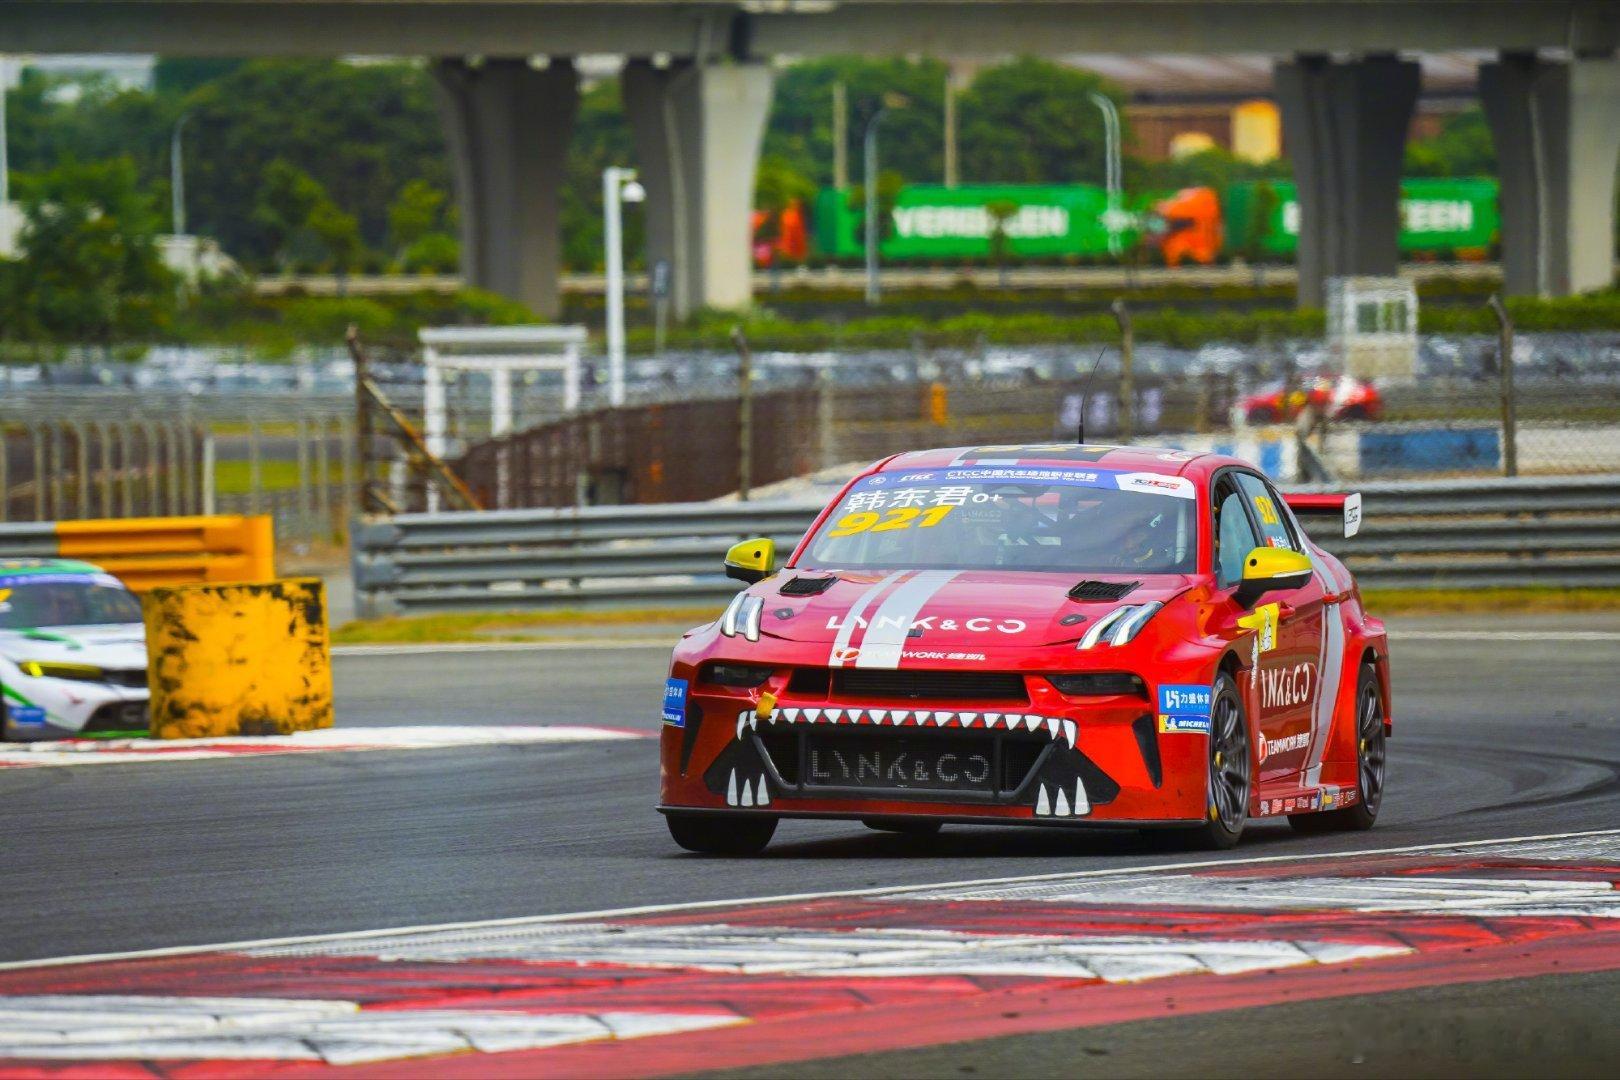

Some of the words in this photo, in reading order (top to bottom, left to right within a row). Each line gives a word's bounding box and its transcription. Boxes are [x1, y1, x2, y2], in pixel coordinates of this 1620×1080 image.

[845, 486, 974, 512] 韩东君
[1254, 496, 1279, 525] 921
[827, 505, 956, 538] 921
[1180, 692, 1210, 705] 力盛体育
